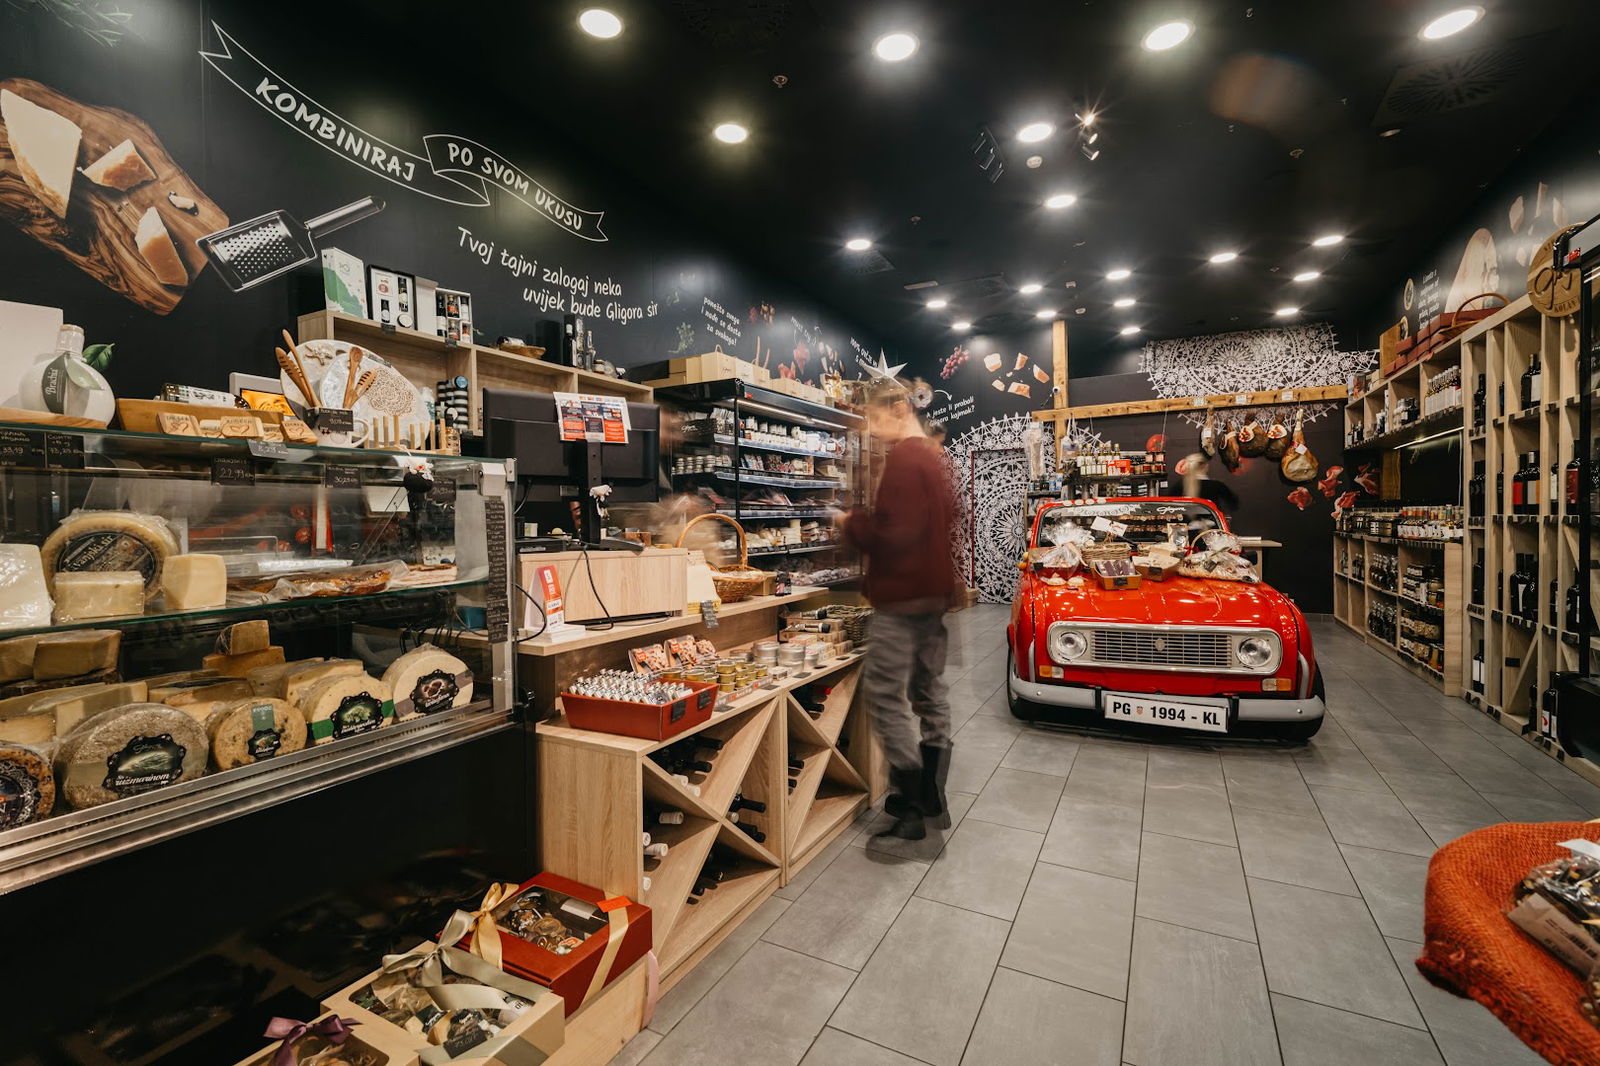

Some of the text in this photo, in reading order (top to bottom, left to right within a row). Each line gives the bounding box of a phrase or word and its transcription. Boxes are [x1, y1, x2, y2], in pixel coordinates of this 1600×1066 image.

[256, 78, 415, 182] KOMBINIRAJ
[448, 143, 582, 230] PO SVOM UKUSU
[458, 226, 622, 297] Tvoj tajni zalogaj neka
[523, 288, 658, 325] uvijek bude Gligora sir
[726, 312, 740, 325] svega
[727, 323, 741, 337] dosta
[1113, 702, 1131, 715] PG
[1150, 706, 1186, 721] 1994
[1203, 711, 1221, 726] KL
